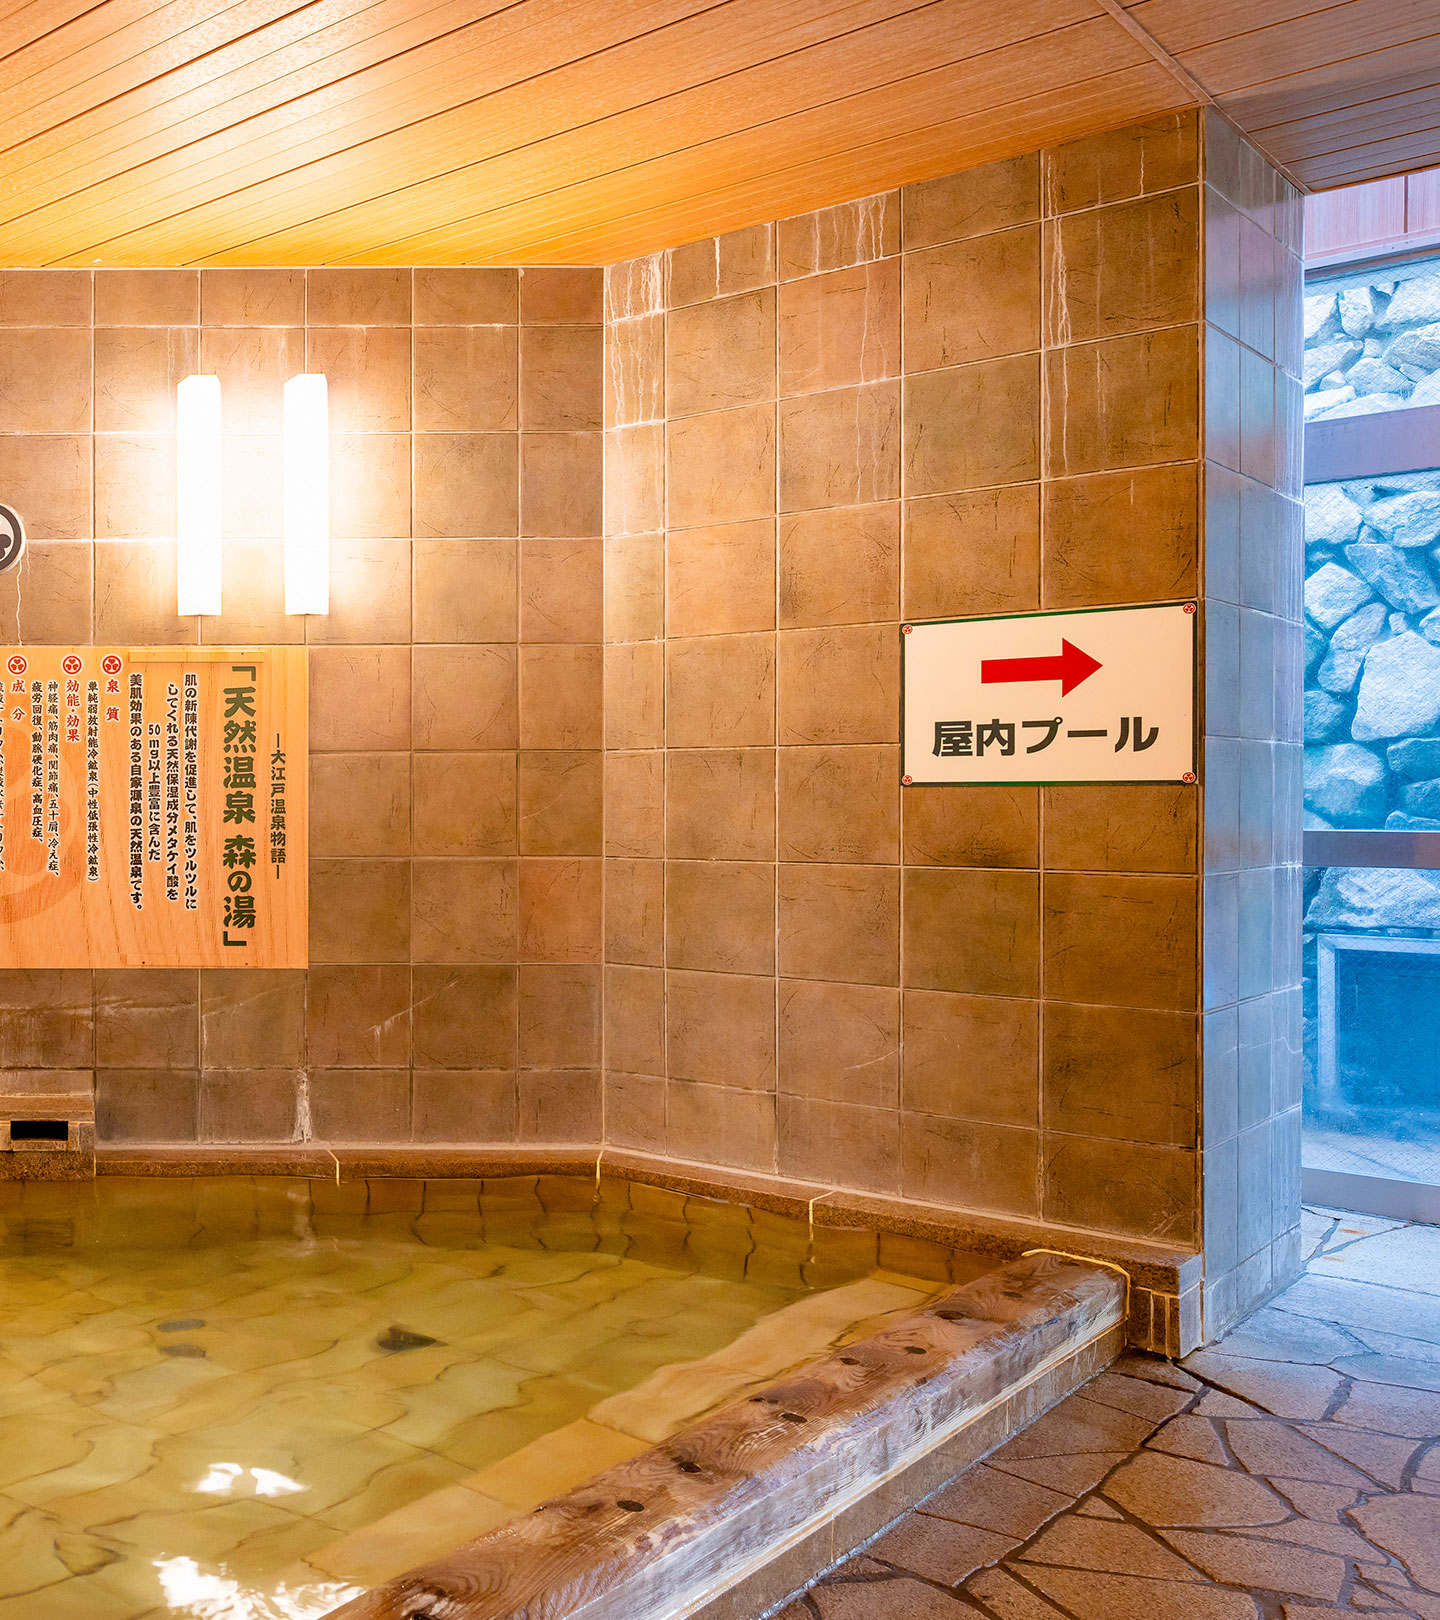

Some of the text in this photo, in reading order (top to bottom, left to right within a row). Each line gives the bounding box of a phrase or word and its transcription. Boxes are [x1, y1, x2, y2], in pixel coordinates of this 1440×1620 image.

[66, 679, 80, 742] 効能・効果
[129, 674, 143, 911] 美肌効果のある自家源泉の天然温泉です。
[166, 684, 179, 901] してくれる天然保湿成分メタケイ酸を
[184, 674, 198, 910] 肌の新陳代謝を促進して、肌をツルツルに
[223, 666, 257, 947] 「天然温泉 森の湯」
[931, 715, 1160, 758] 屋内プール
